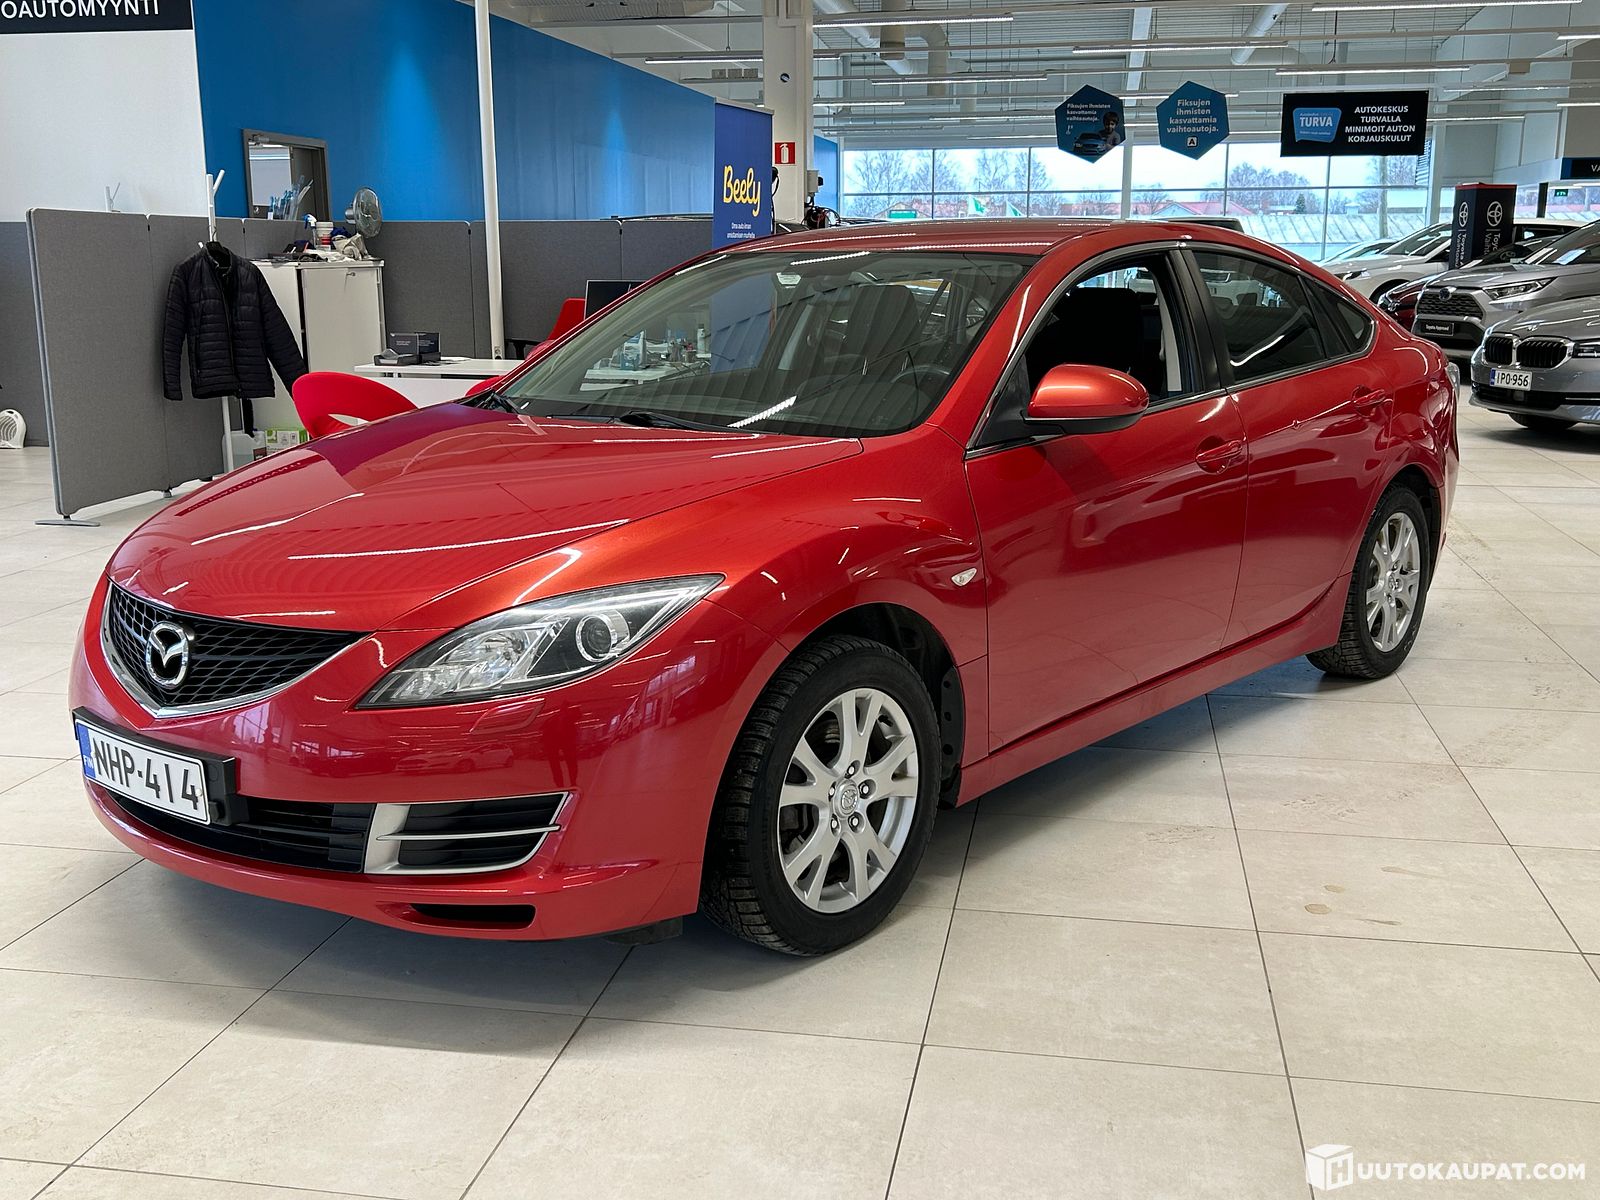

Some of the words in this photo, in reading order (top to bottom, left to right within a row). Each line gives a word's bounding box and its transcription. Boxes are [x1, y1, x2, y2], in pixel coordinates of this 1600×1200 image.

[1177, 99, 1210, 107] Fiksujen
[1354, 105, 1409, 114] AUTOKESKUS
[1169, 116, 1217, 124] kasvattamia
[1300, 116, 1333, 127] TURVA
[1361, 115, 1401, 123] TURVALLA
[1167, 125, 1219, 134] vaihtoautoja.
[1344, 125, 1385, 133] MINIMOIT
[1386, 125, 1416, 133] AUTON
[1348, 134, 1411, 143] KORJAUSKULUT
[723, 165, 761, 217] Beely
[92, 737, 199, 811] NHP-414
